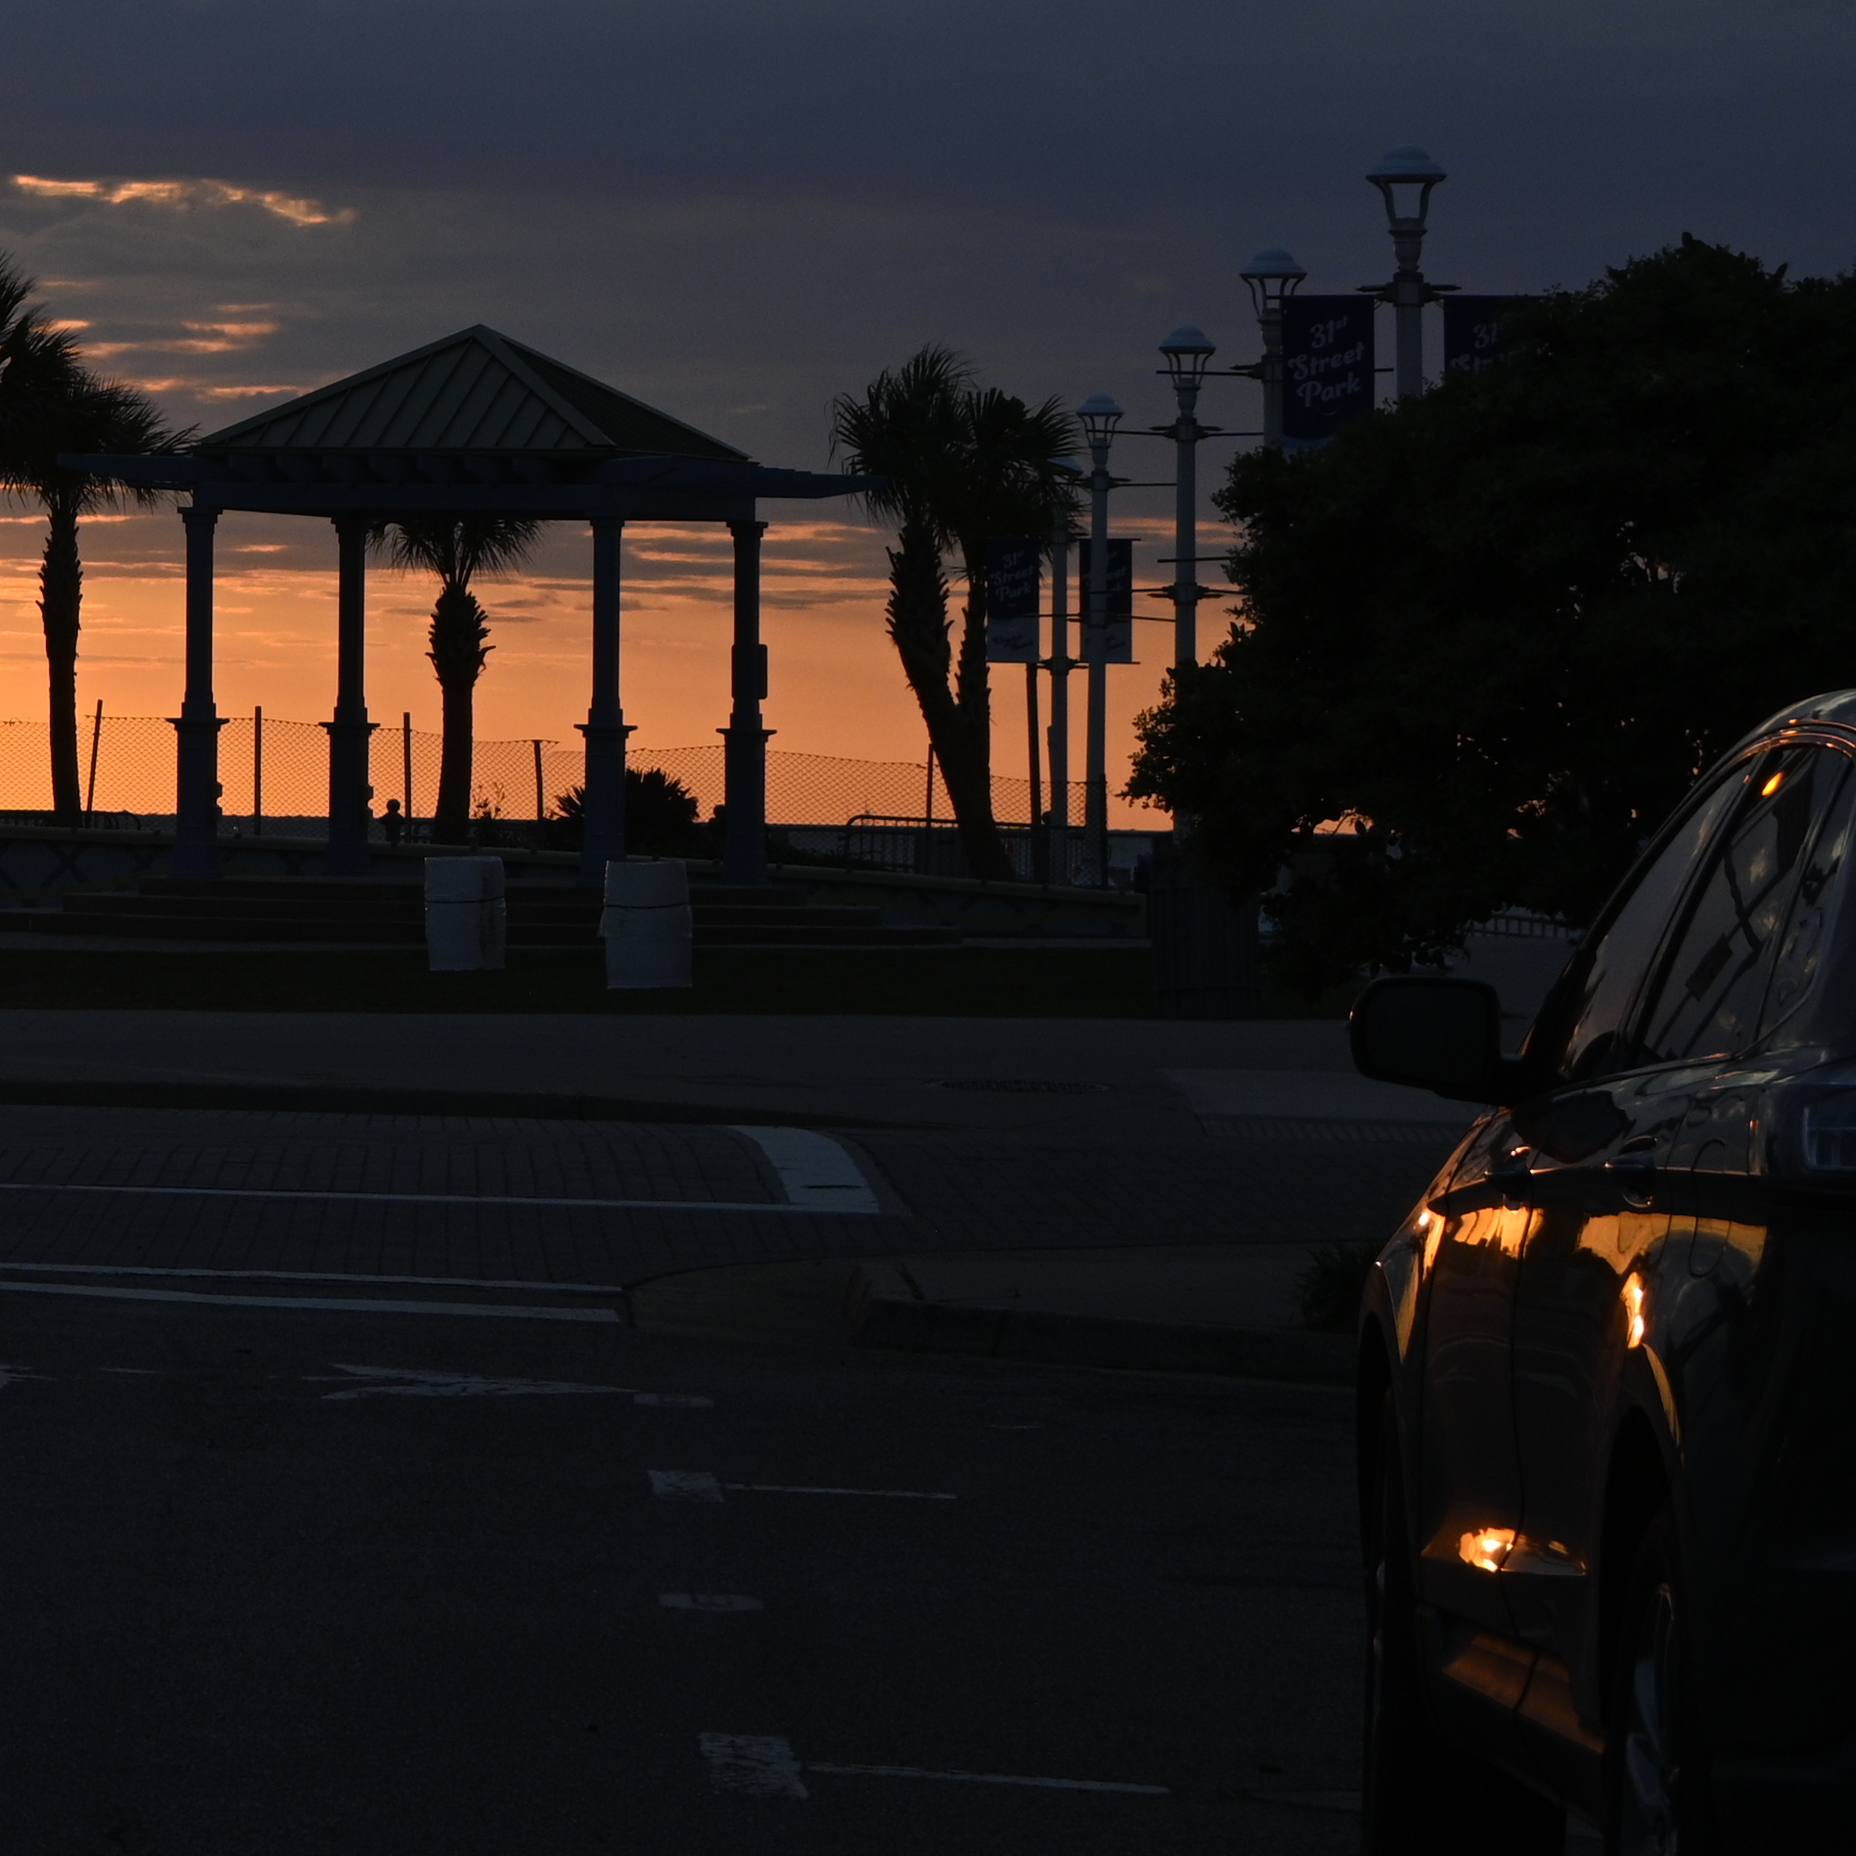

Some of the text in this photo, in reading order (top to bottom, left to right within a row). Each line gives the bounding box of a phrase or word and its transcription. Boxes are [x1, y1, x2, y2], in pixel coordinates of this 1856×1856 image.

[1309, 315, 1348, 349] 31st
[1286, 340, 1366, 381] Street
[1296, 370, 1362, 409] Park
[989, 564, 1034, 586] Street
[995, 582, 1033, 602] Park
